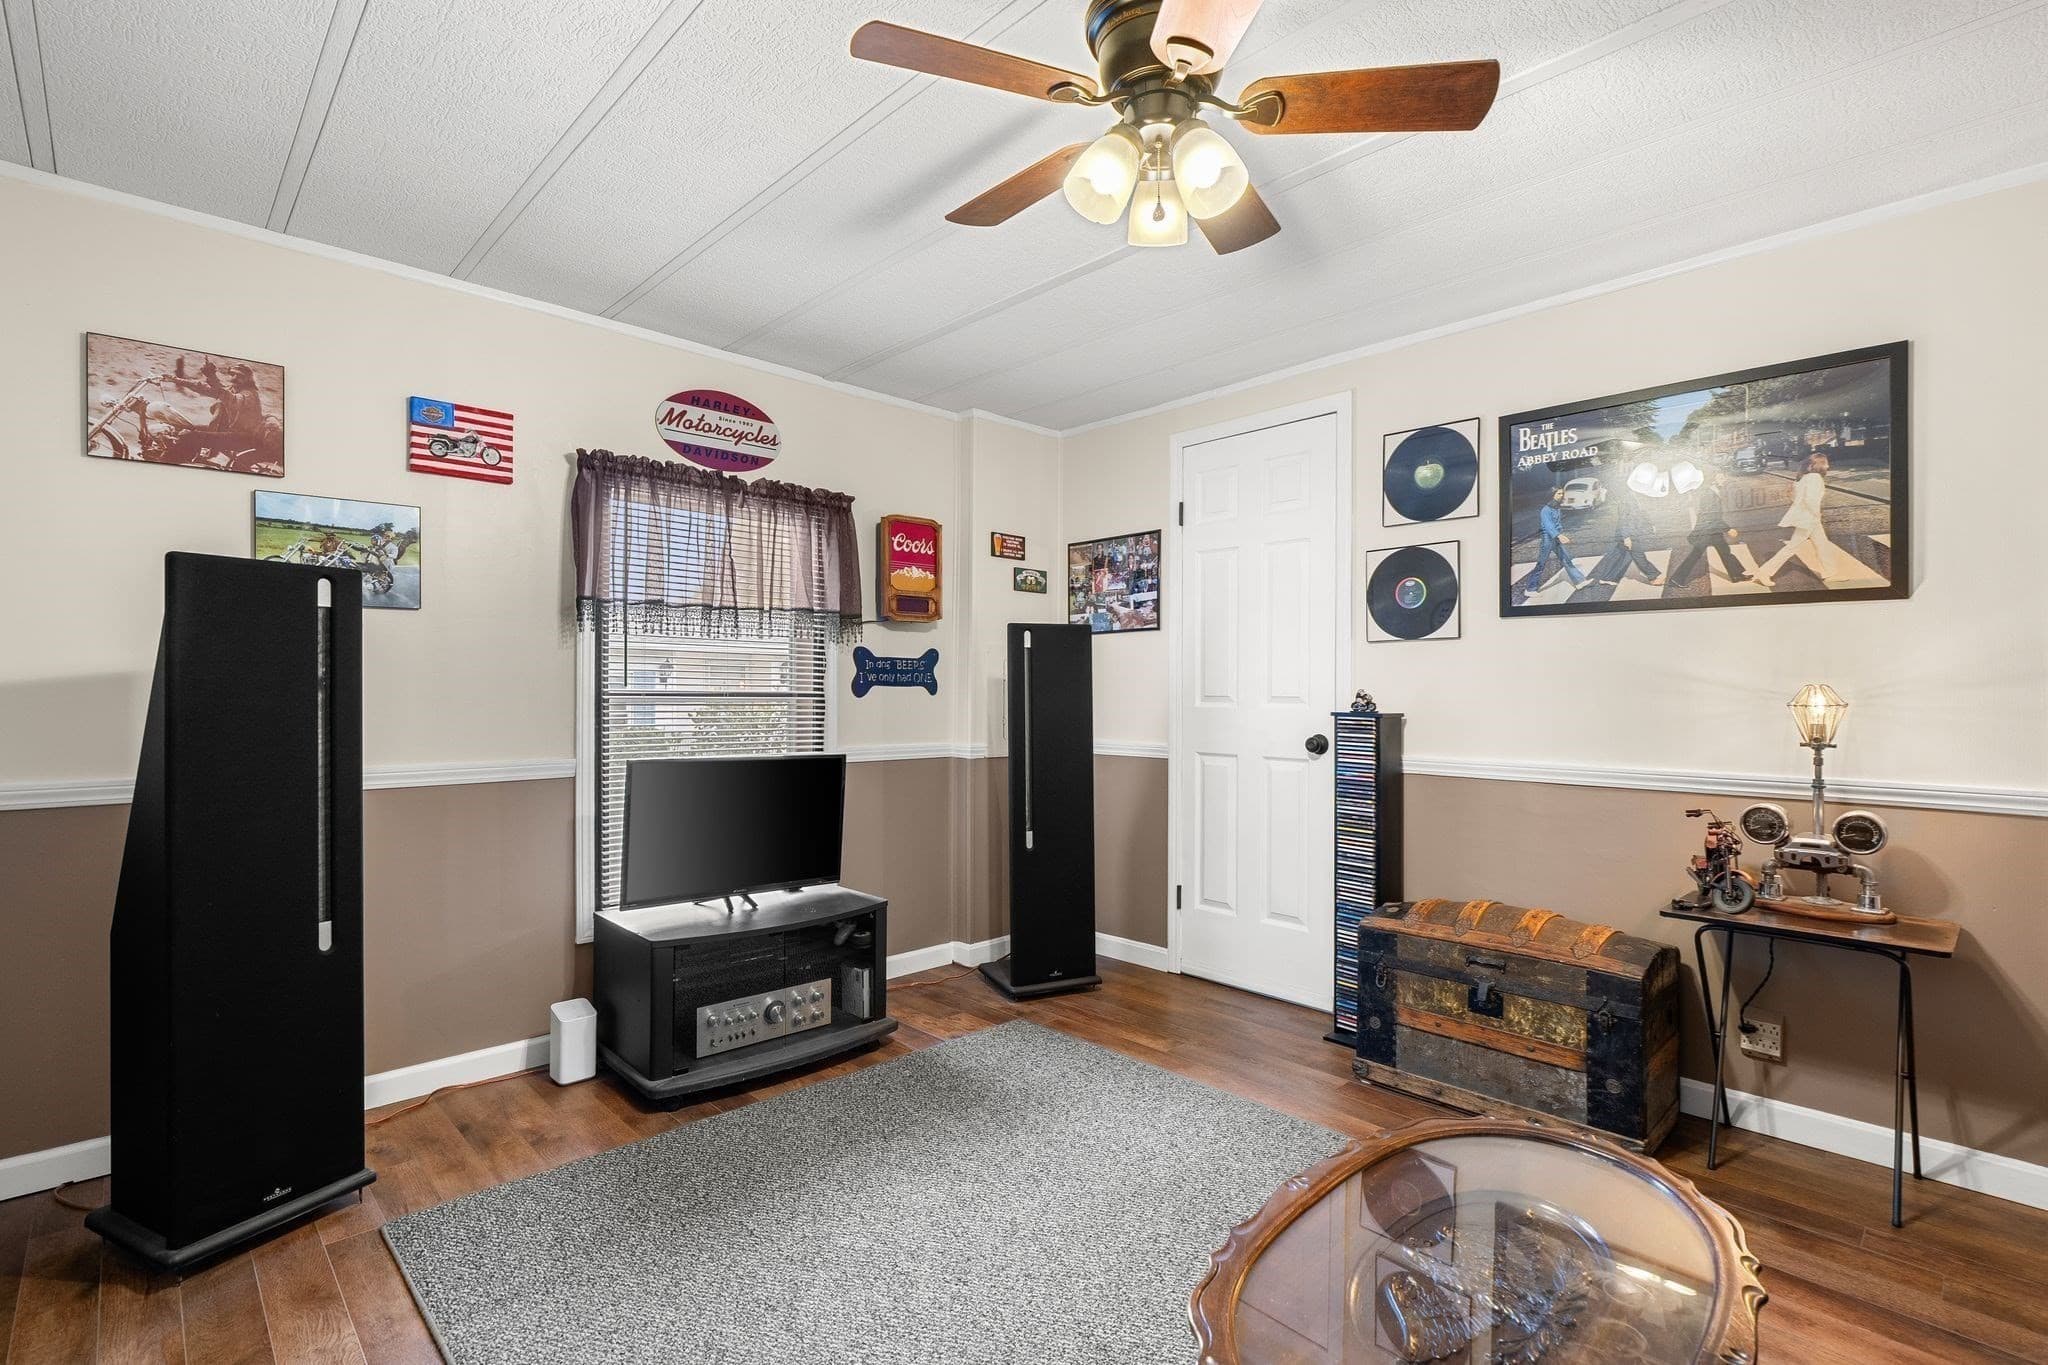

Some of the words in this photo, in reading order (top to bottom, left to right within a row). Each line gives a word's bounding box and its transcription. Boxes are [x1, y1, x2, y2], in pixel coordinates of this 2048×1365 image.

[659, 407, 780, 447] Motorcycles
[718, 416, 736, 424] Since
[1541, 422, 1555, 431] THE
[1518, 428, 1578, 452] BEATLES
[683, 443, 760, 466] DAVIDSON
[1517, 452, 1558, 467] ABBEY
[1562, 446, 1599, 461] ROAD
[891, 533, 935, 555] Coors
[865, 659, 874, 670] In
[878, 673, 896, 683] only
[896, 673, 912, 683] had
[913, 672, 933, 683] ONE
